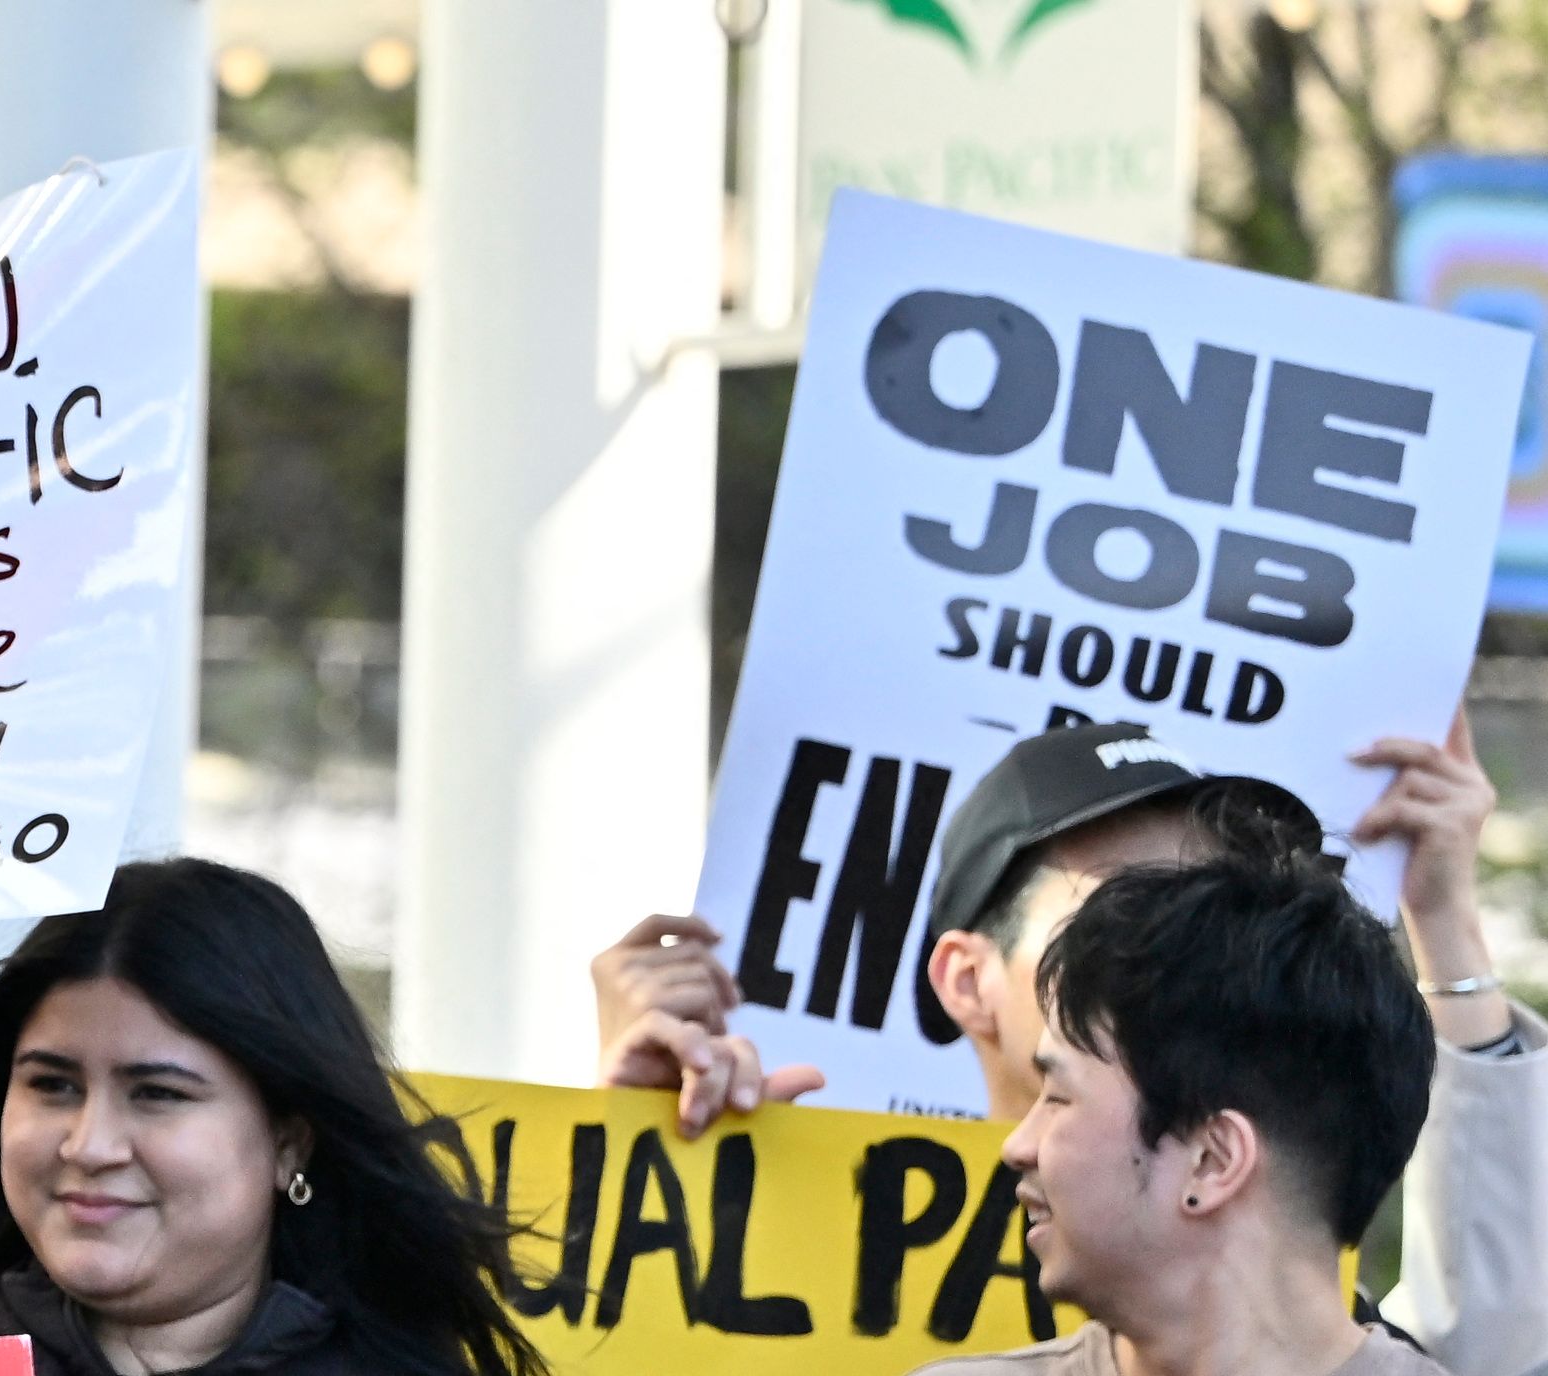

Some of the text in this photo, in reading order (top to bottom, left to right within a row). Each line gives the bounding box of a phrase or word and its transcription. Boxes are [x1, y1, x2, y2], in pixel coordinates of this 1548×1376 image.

[864, 288, 1434, 544] ONE
[902, 481, 1356, 648] JOB
[938, 597, 1286, 725] SHOULD
[424, 1114, 1060, 1343] UAL PA
